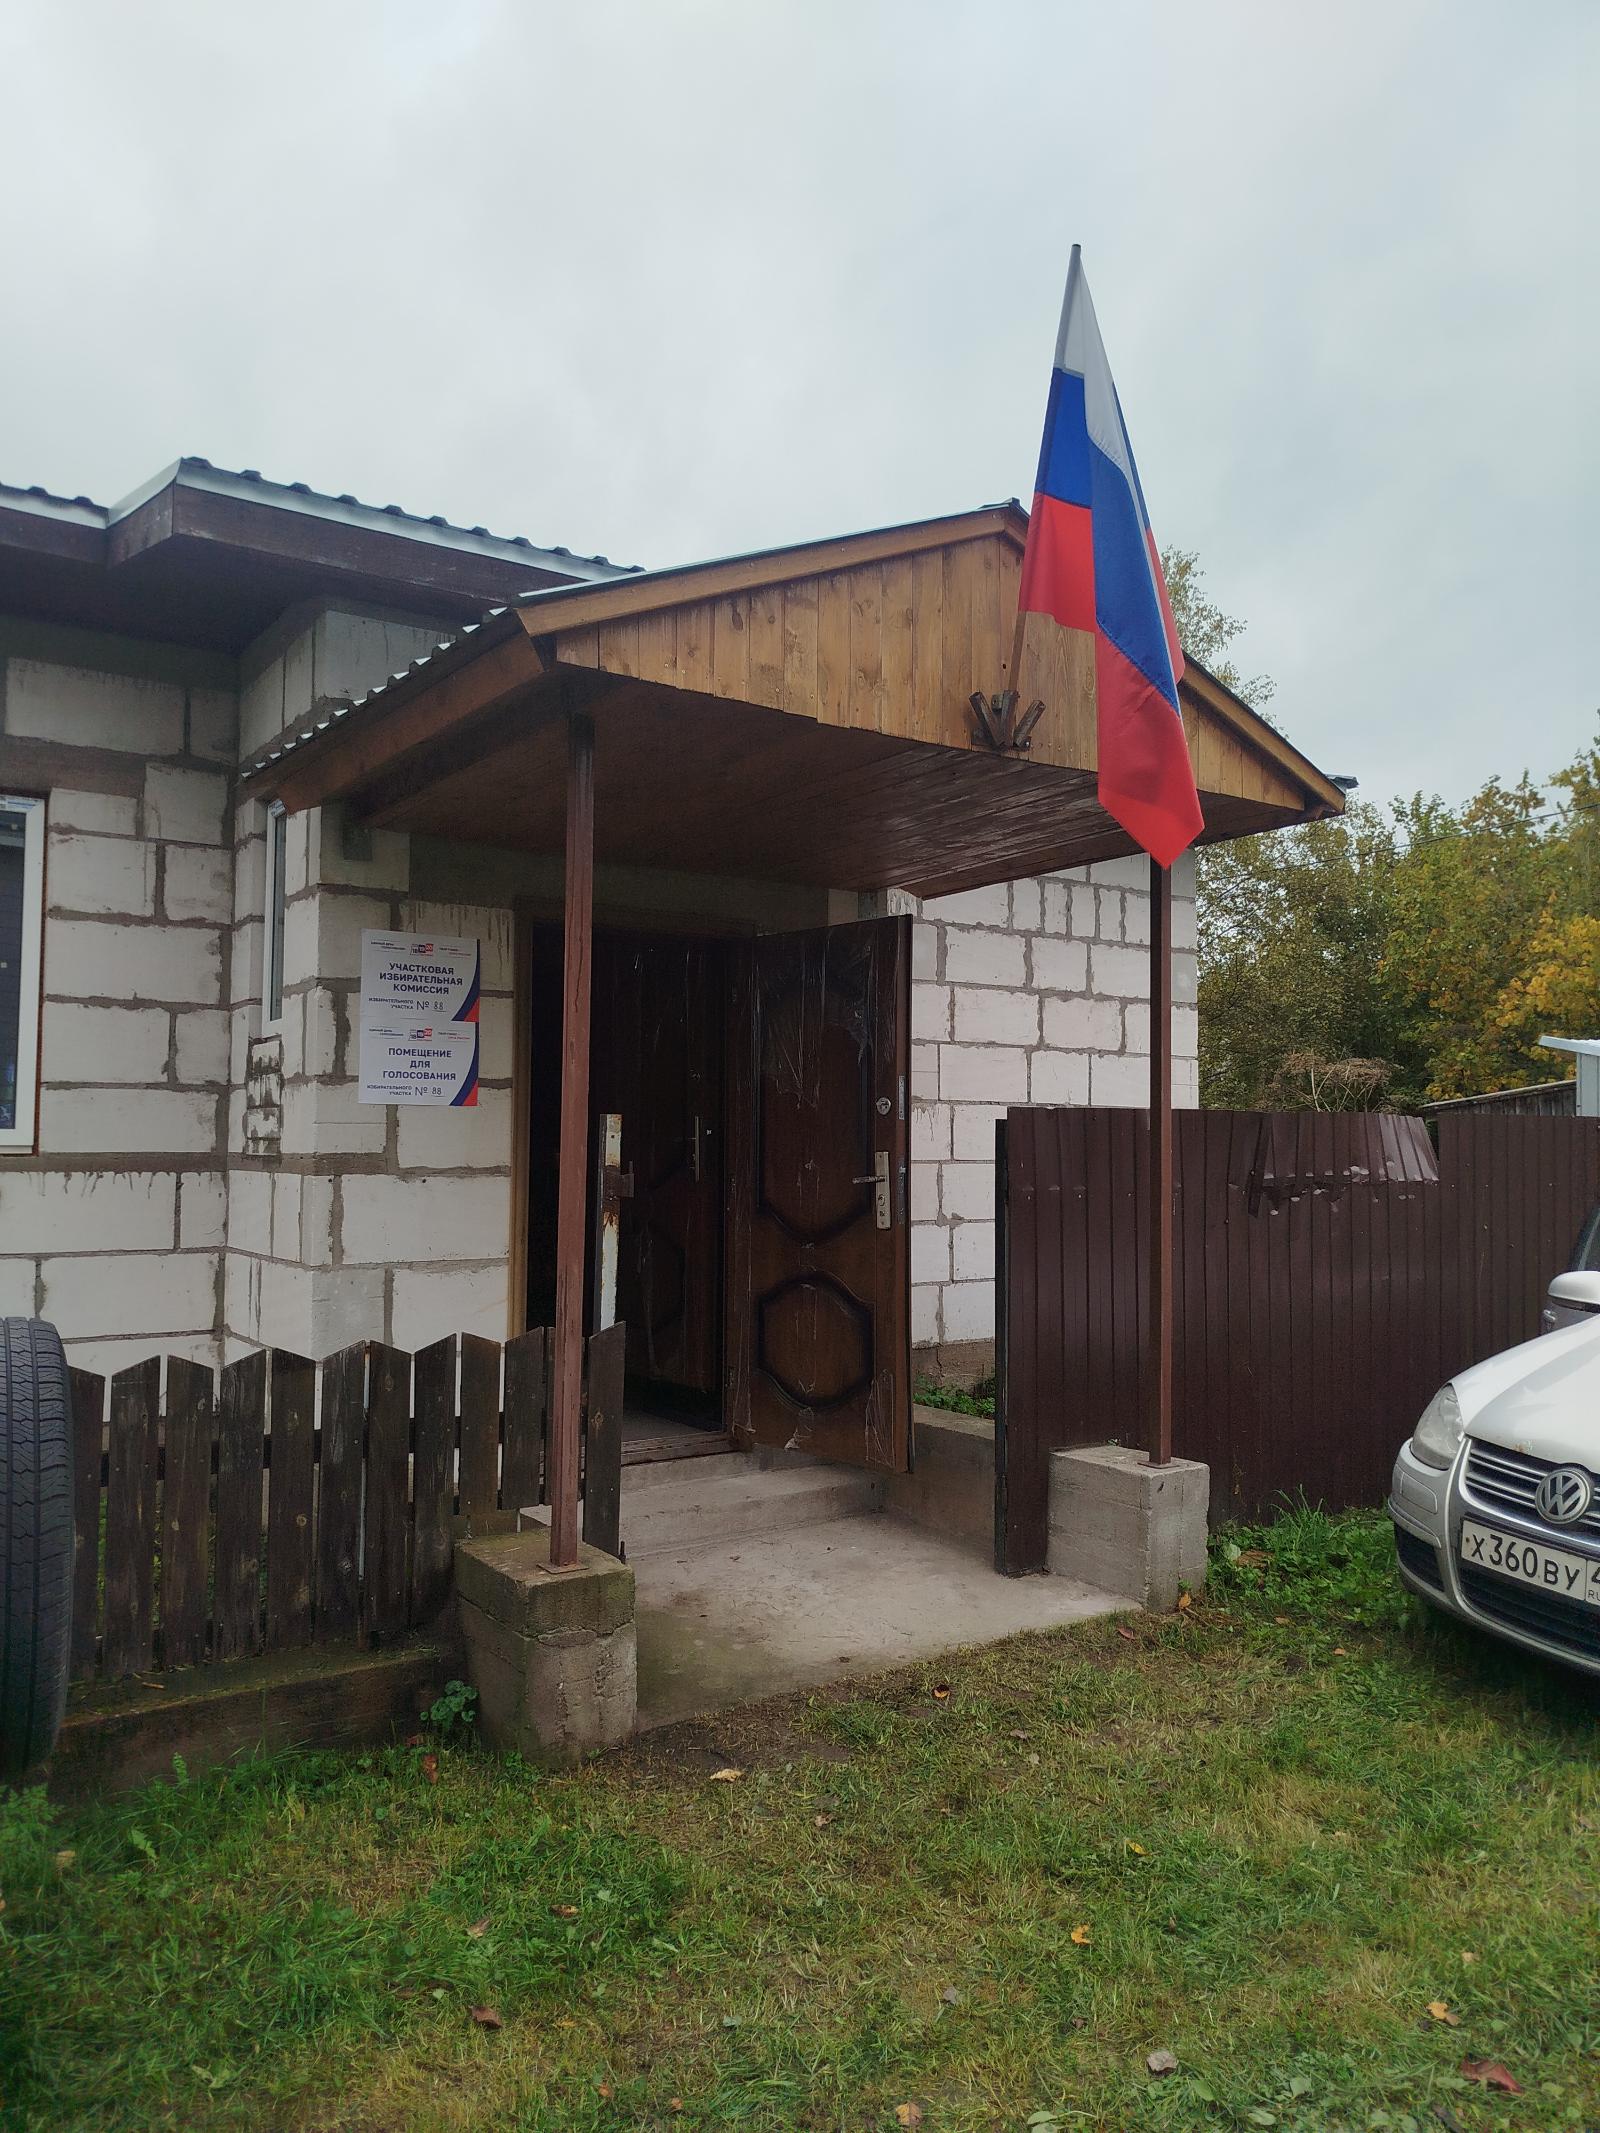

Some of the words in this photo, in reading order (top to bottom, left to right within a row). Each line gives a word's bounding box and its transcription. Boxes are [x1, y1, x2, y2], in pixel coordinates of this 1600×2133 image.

[389, 962, 454, 975] УЧАСТКОВАЯ
[379, 973, 463, 986] ИЗБИРАТЕЛЬНАЯ
[393, 983, 449, 995] КОМИССИЯ
[368, 997, 414, 1005] ИЗБИРАТЕЛЬНОГО
[433, 1001, 444, 1010] 88
[388, 1047, 452, 1058] ПОМЕЩЕНИЕ
[409, 1060, 431, 1069] ДЛЯ
[382, 1070, 456, 1081] ГОЛОСОВАНИЯ
[366, 1083, 413, 1091] ИЗБИРАТЕЛЬНОГО
[431, 1086, 442, 1095] 88
